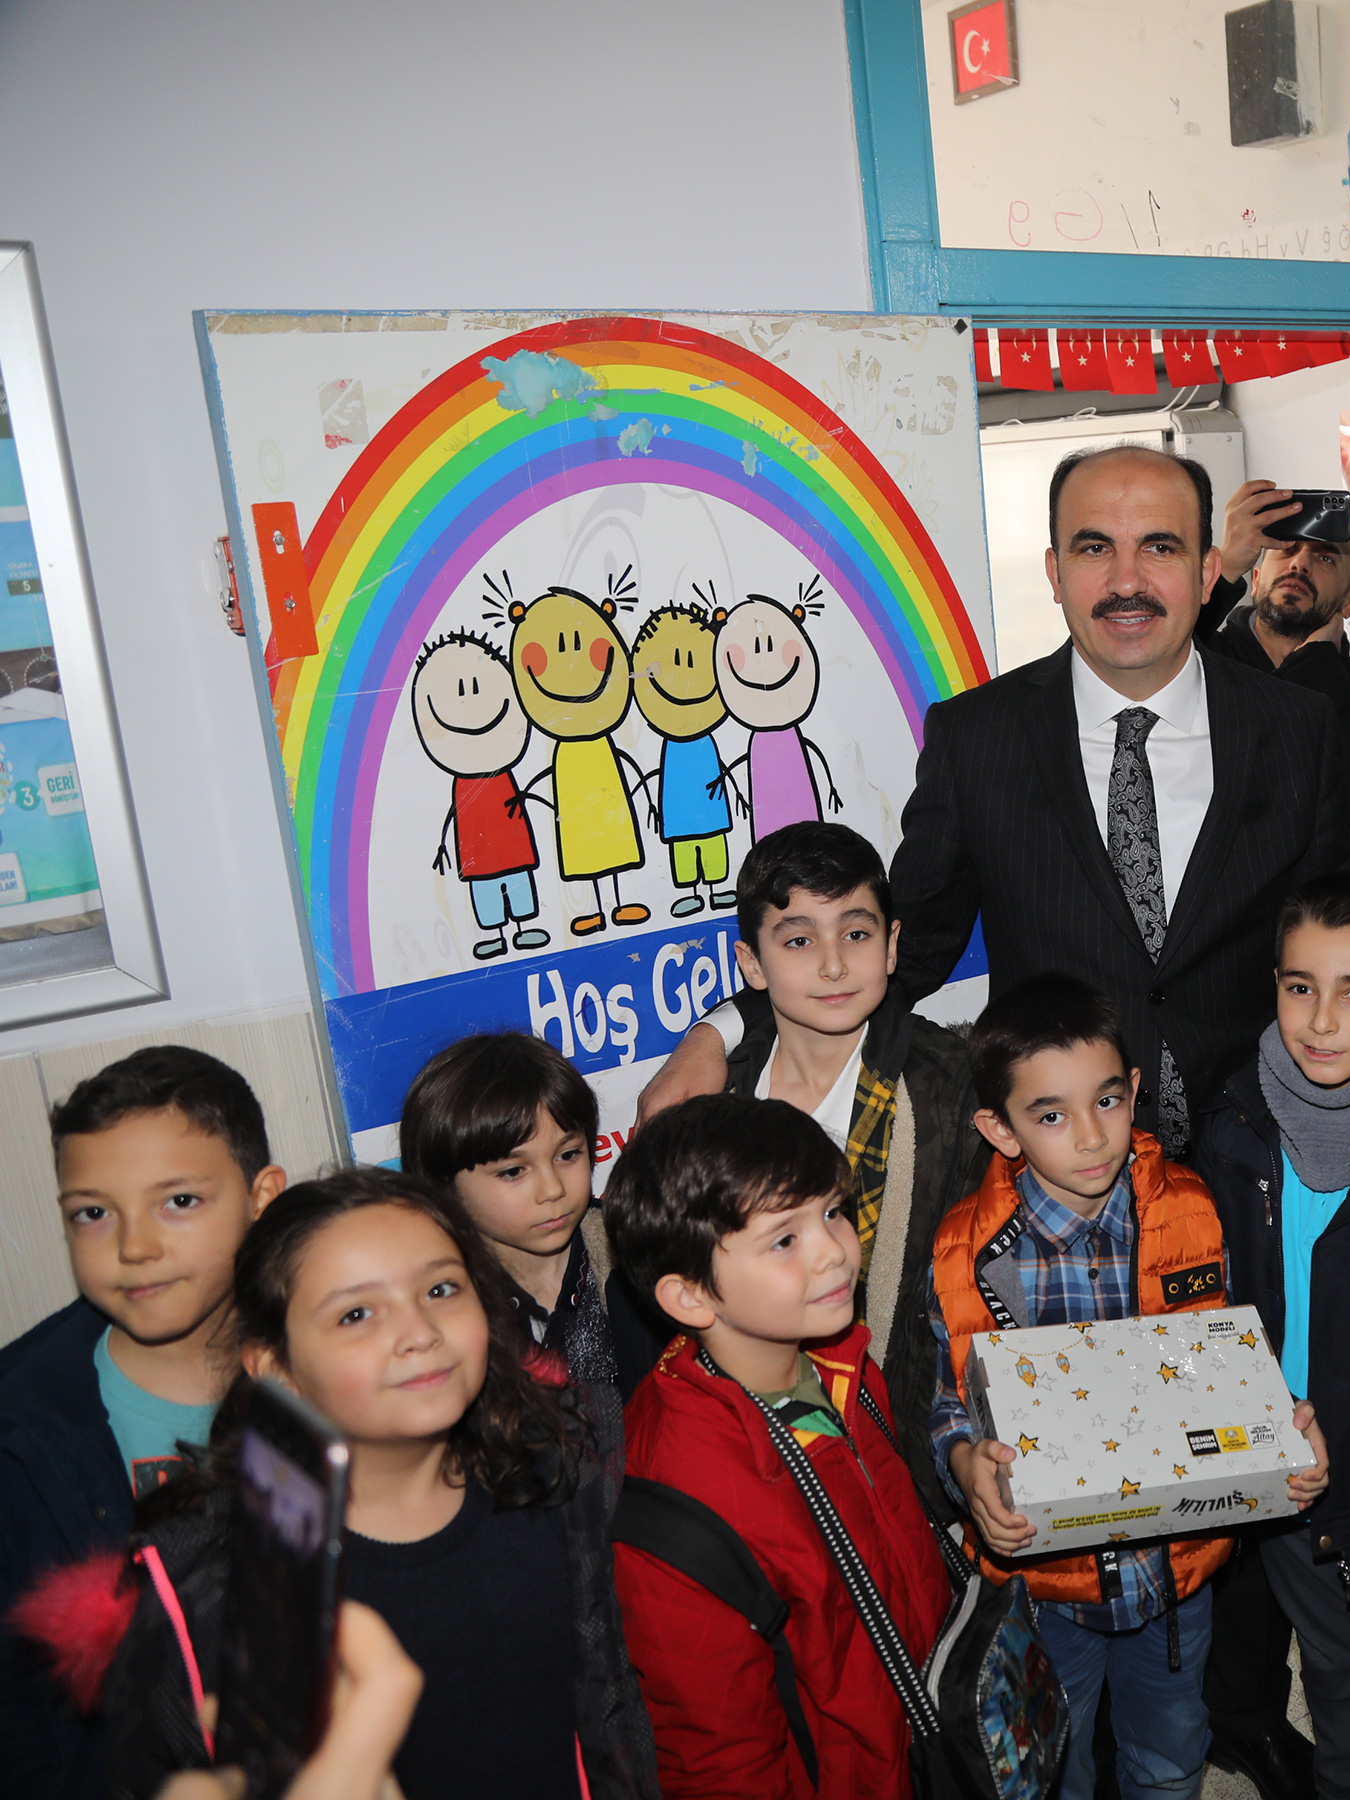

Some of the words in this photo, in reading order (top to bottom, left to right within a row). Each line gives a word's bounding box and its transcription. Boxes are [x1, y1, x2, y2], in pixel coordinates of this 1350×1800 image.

[23, 579, 31, 592] 5
[46, 771, 76, 793] GERİ
[20, 786, 35, 807] 3
[653, 931, 744, 1033] Gel
[527, 969, 639, 1066] Hoş
[1189, 1434, 1215, 1444] BENİM
[1172, 1489, 1245, 1517] ŞİVLİLİK
